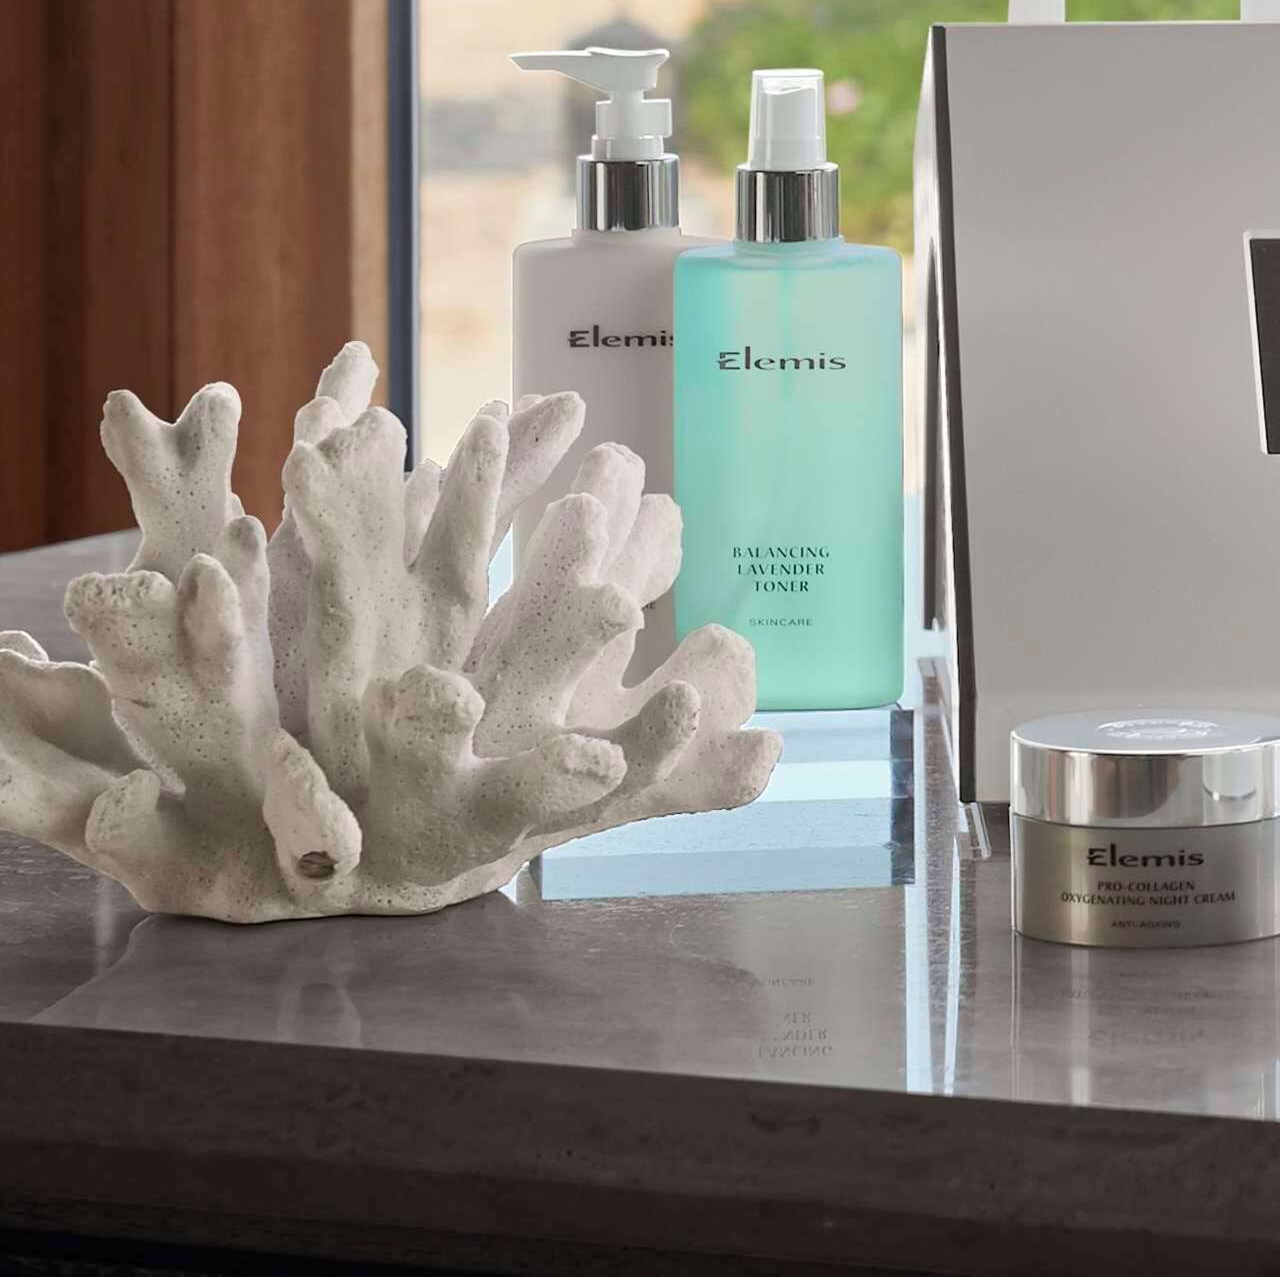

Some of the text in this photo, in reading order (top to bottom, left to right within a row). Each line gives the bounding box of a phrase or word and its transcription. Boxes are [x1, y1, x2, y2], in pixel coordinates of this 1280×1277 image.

[717, 346, 847, 370] Elemis
[732, 547, 829, 559] BALANCING
[737, 564, 825, 575] LAVENDER
[754, 581, 809, 592] TONER
[748, 618, 813, 626] SKINCARE
[1087, 843, 1205, 867] Elemis
[1097, 881, 1195, 892] PRO-COLLAGEN
[1060, 891, 1236, 906] OXYGENATING NIGHT CREAM
